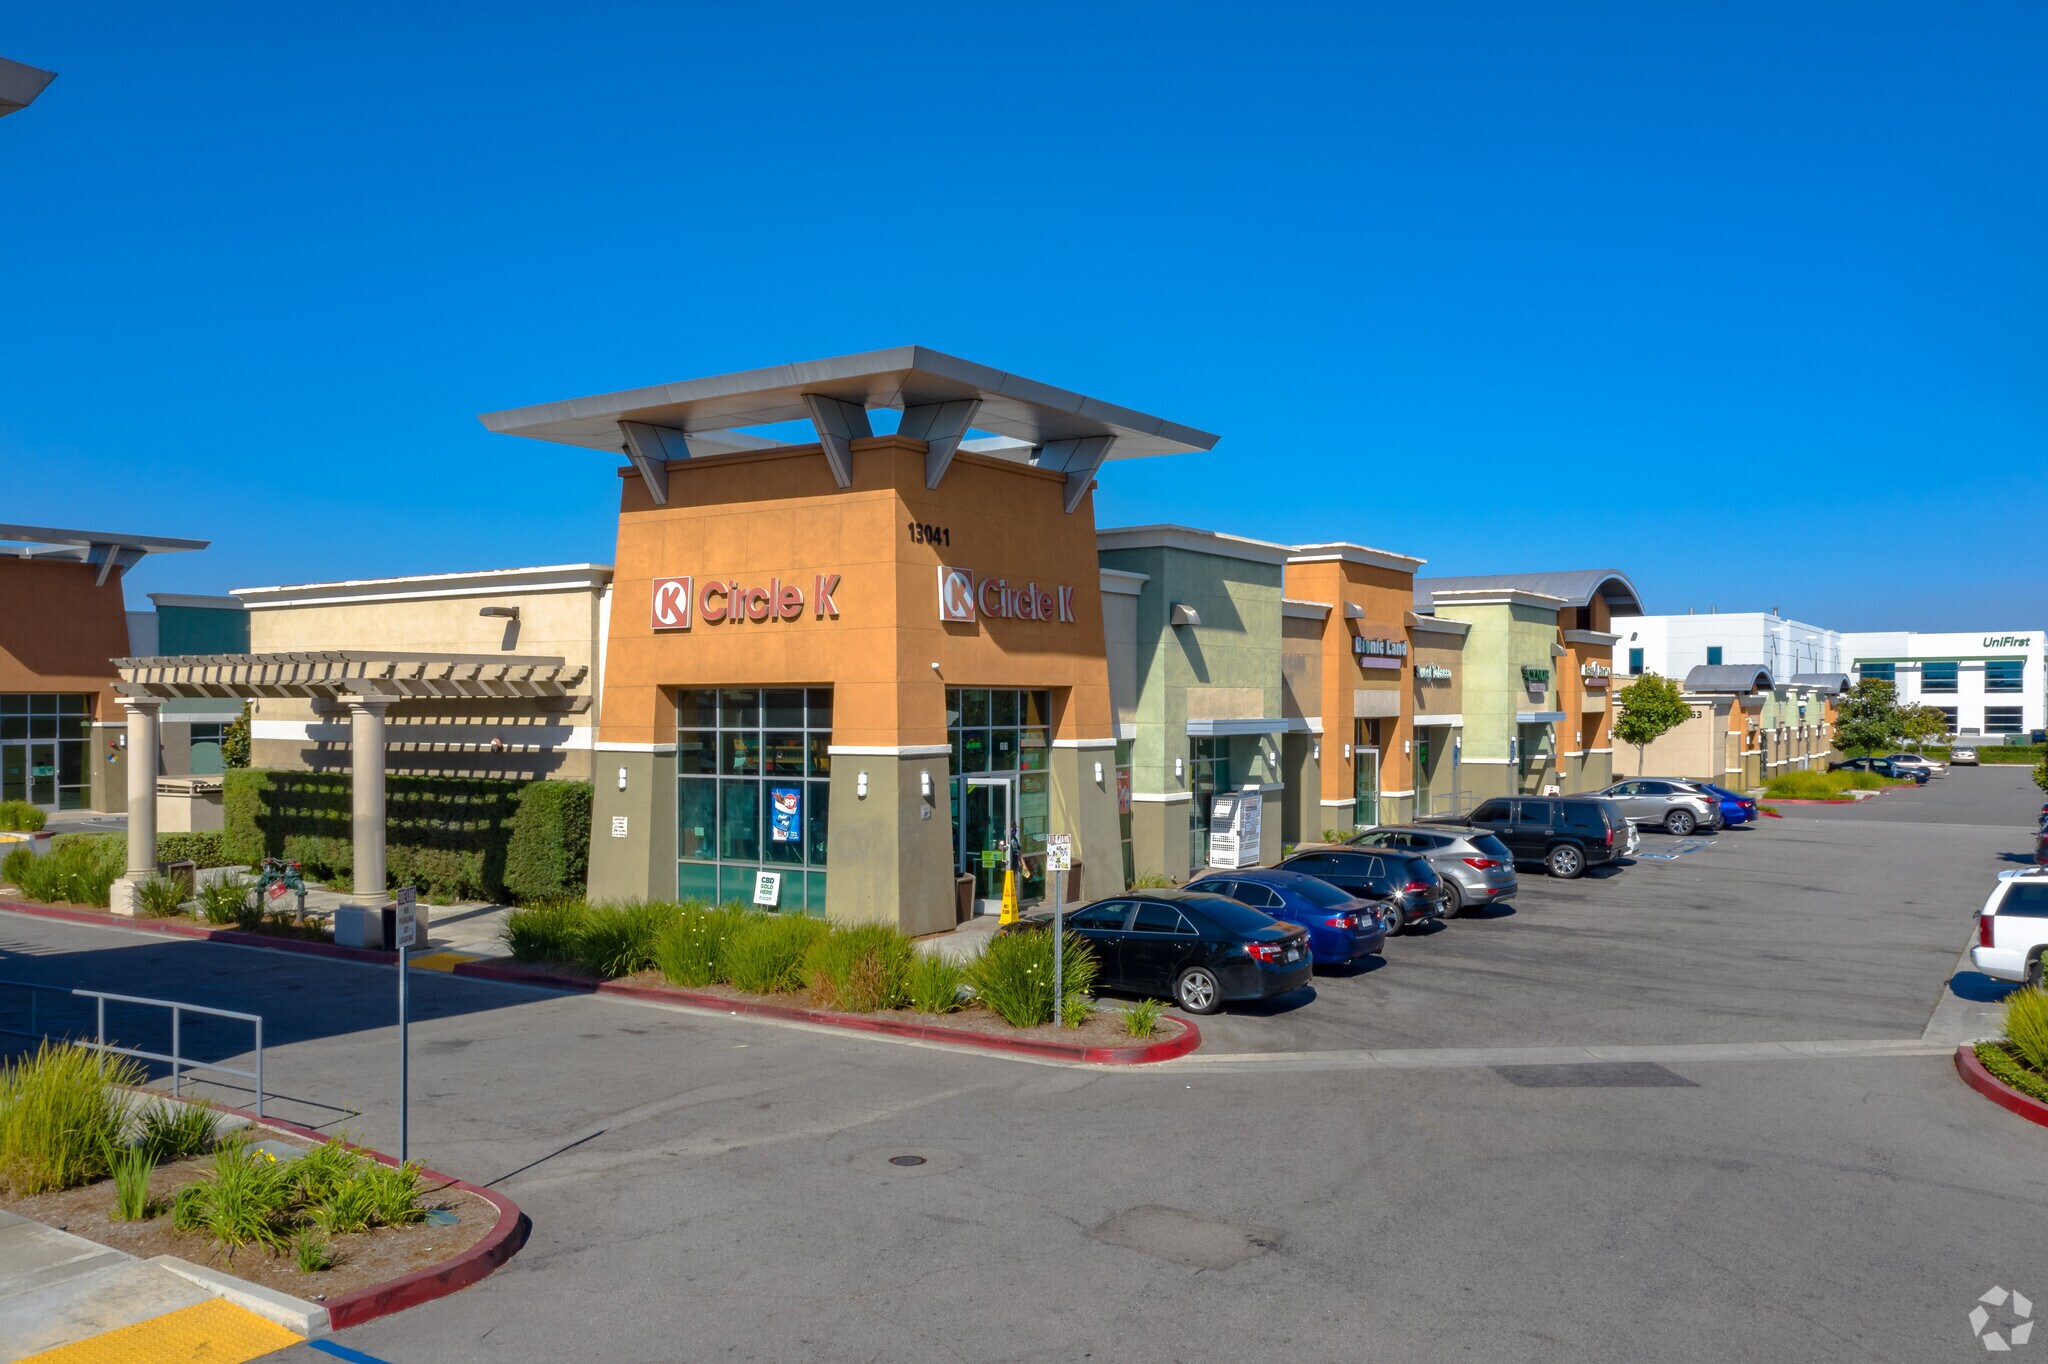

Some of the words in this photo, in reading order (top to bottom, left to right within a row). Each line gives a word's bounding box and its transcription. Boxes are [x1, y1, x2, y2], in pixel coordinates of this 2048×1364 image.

[908, 522, 950, 547] 13041
[699, 578, 804, 624] Circle
[813, 574, 841, 619] K
[978, 577, 1055, 621] Circle
[1058, 585, 1077, 622] K
[1353, 636, 1384, 654] Bionic
[1386, 640, 1407, 656] Land
[1983, 636, 2031, 648] UniFirst
[761, 876, 775, 884] CBD
